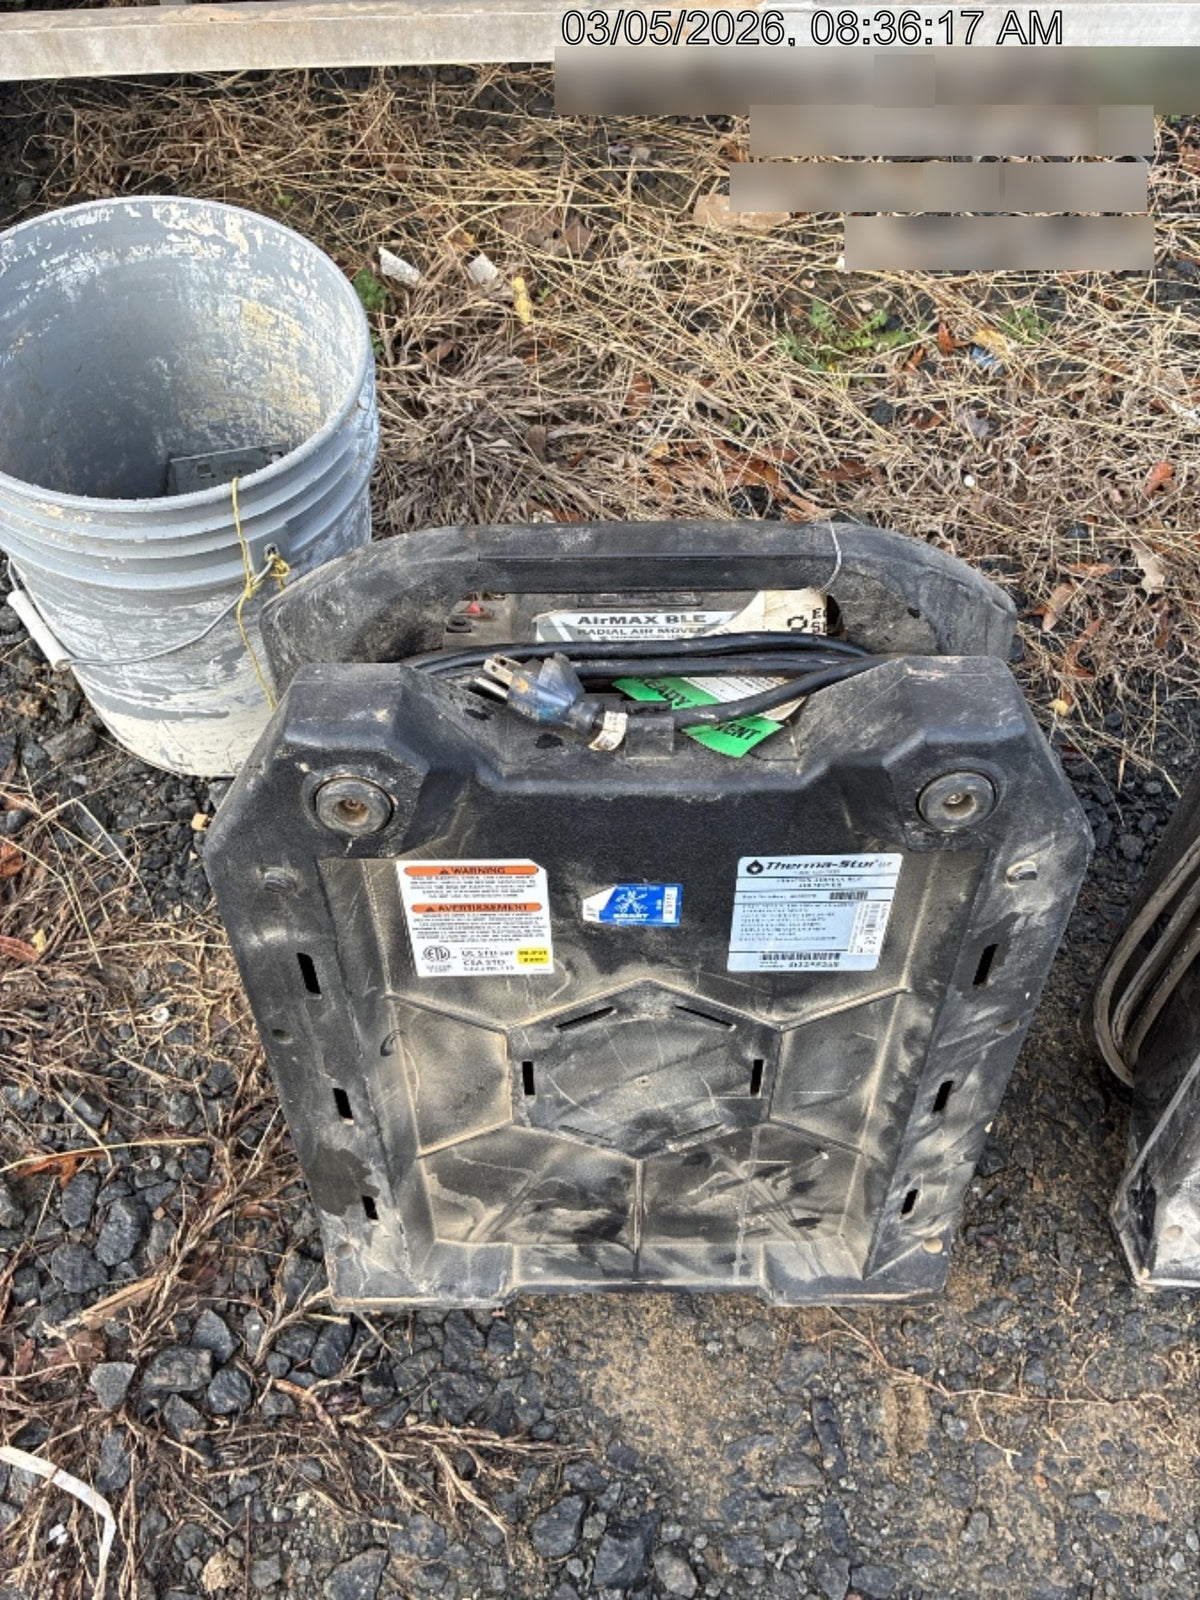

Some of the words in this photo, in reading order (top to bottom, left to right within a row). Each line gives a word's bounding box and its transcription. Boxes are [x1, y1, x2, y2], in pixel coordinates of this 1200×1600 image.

[577, 614, 659, 625] AirMAX
[664, 614, 707, 623] BLE
[577, 628, 627, 636] RADIAL
[451, 866, 506, 875] WARNING
